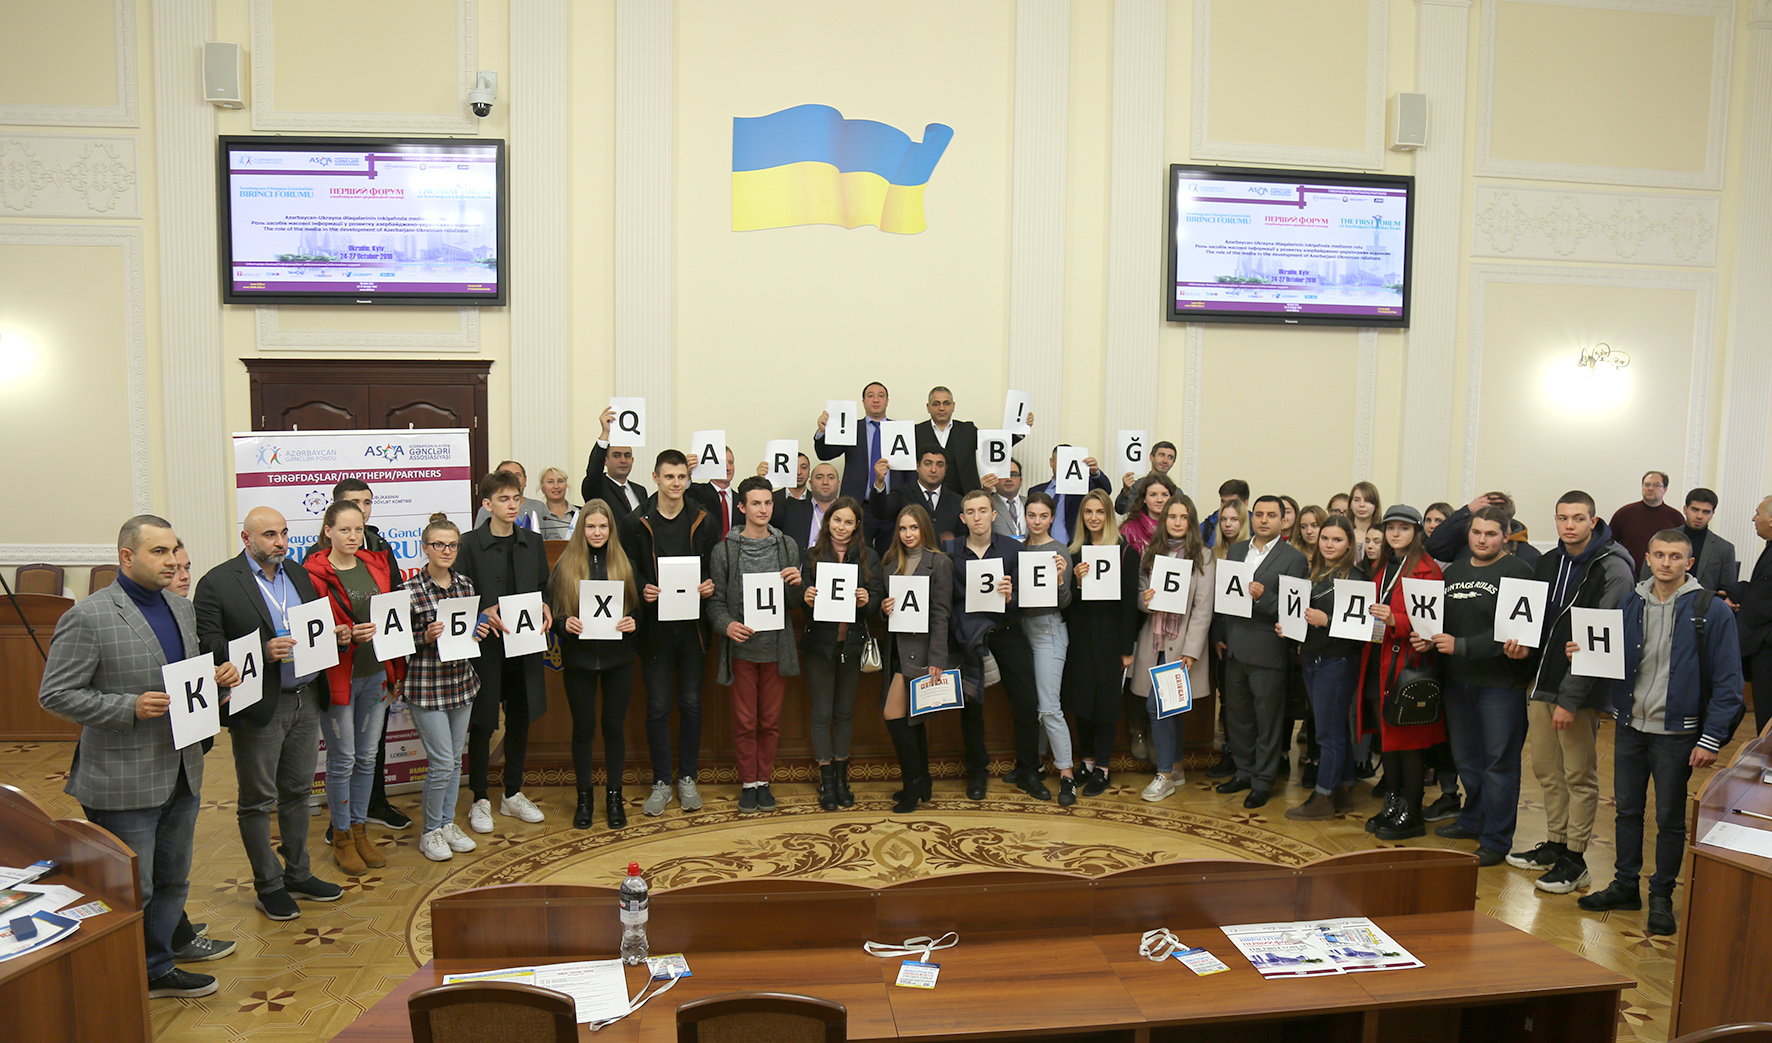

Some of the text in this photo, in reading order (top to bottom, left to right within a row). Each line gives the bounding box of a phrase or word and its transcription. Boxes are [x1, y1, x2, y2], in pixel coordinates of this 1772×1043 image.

[618, 410, 640, 436] Q
[840, 412, 846, 434] !
[1016, 402, 1024, 422] !
[700, 444, 720, 464] A
[890, 434, 910, 456] A
[990, 440, 1006, 462] B
[1126, 436, 1142, 462] Ğ
[774, 452, 790, 474] R
[1066, 460, 1082, 480] A
[1034, 566, 1046, 586] Е
[1096, 560, 1110, 580] Р
[832, 578, 846, 600] Е
[980, 574, 994, 594] З
[1164, 572, 1180, 592] Б
[1226, 576, 1244, 598] А
[1474, 581, 1498, 594] RULES
[594, 594, 612, 618] Х
[756, 588, 776, 614] Ц
[900, 590, 920, 612] А
[1288, 588, 1300, 618] Й
[1342, 594, 1366, 624] Д
[1410, 594, 1436, 620] Ж
[1510, 596, 1532, 622] А
[308, 618, 324, 648] Р
[384, 608, 404, 636] А
[452, 612, 466, 636] Б
[516, 610, 536, 634] А
[1588, 626, 1610, 654] Н
[240, 652, 258, 682] А
[184, 676, 208, 714] К
